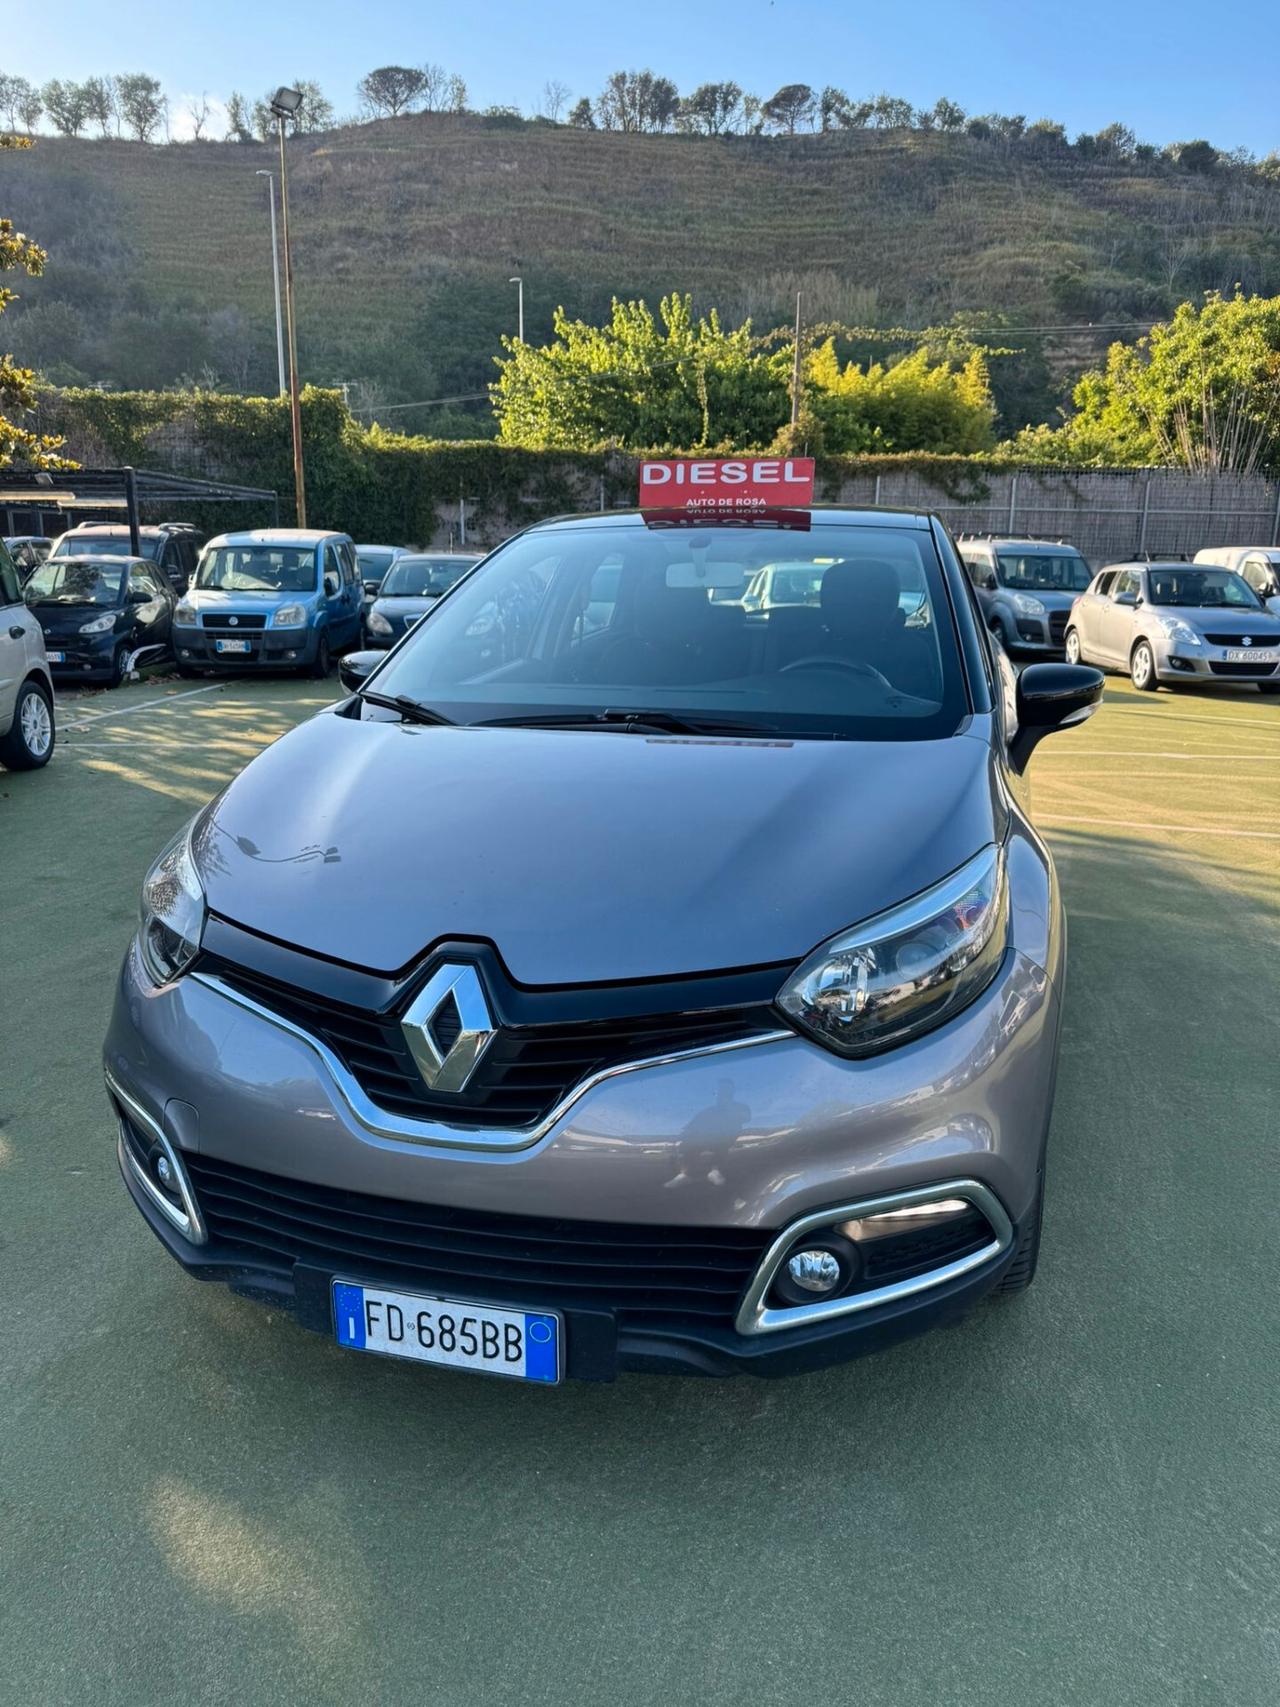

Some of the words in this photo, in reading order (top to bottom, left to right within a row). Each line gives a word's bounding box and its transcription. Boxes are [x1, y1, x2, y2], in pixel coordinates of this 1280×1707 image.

[642, 461, 810, 485] DIESEL
[686, 498, 716, 506] AUTO
[718, 498, 733, 506] DE
[735, 498, 767, 506] ROSA
[365, 1300, 404, 1341] FD
[416, 1311, 523, 1362] 685BB
